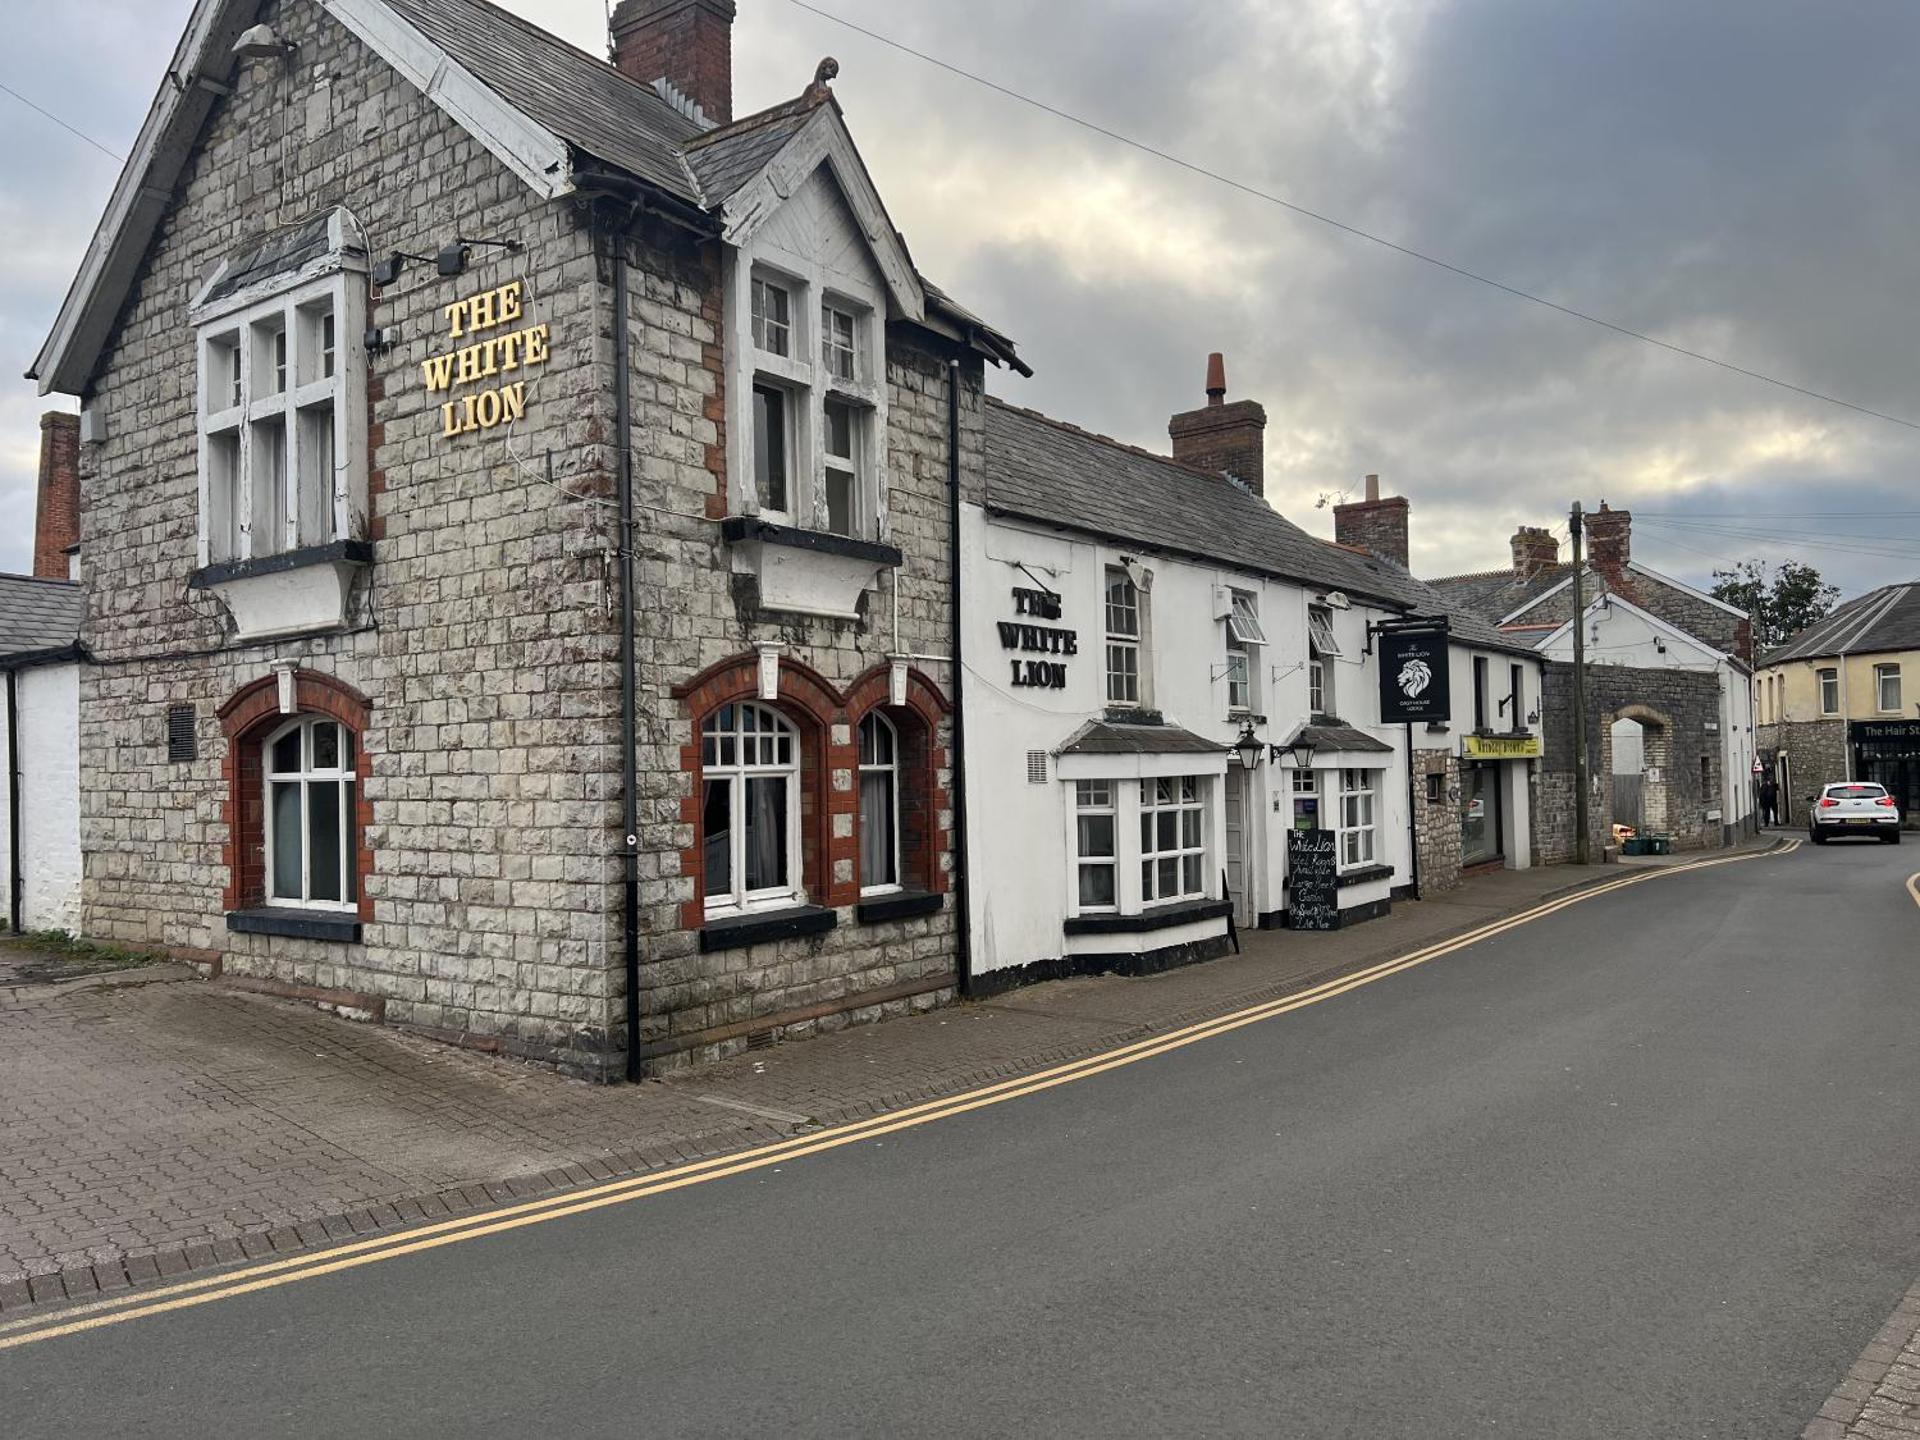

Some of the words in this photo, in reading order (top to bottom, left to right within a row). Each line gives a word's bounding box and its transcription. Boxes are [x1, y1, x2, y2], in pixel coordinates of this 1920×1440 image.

[445, 281, 521, 338] THE
[421, 323, 549, 391] WHITE
[442, 381, 525, 438] LION
[997, 621, 1078, 655] WHITE
[1010, 659, 1067, 689] LION
[1864, 726, 1882, 737] The
[1884, 725, 1906, 737] Hair
